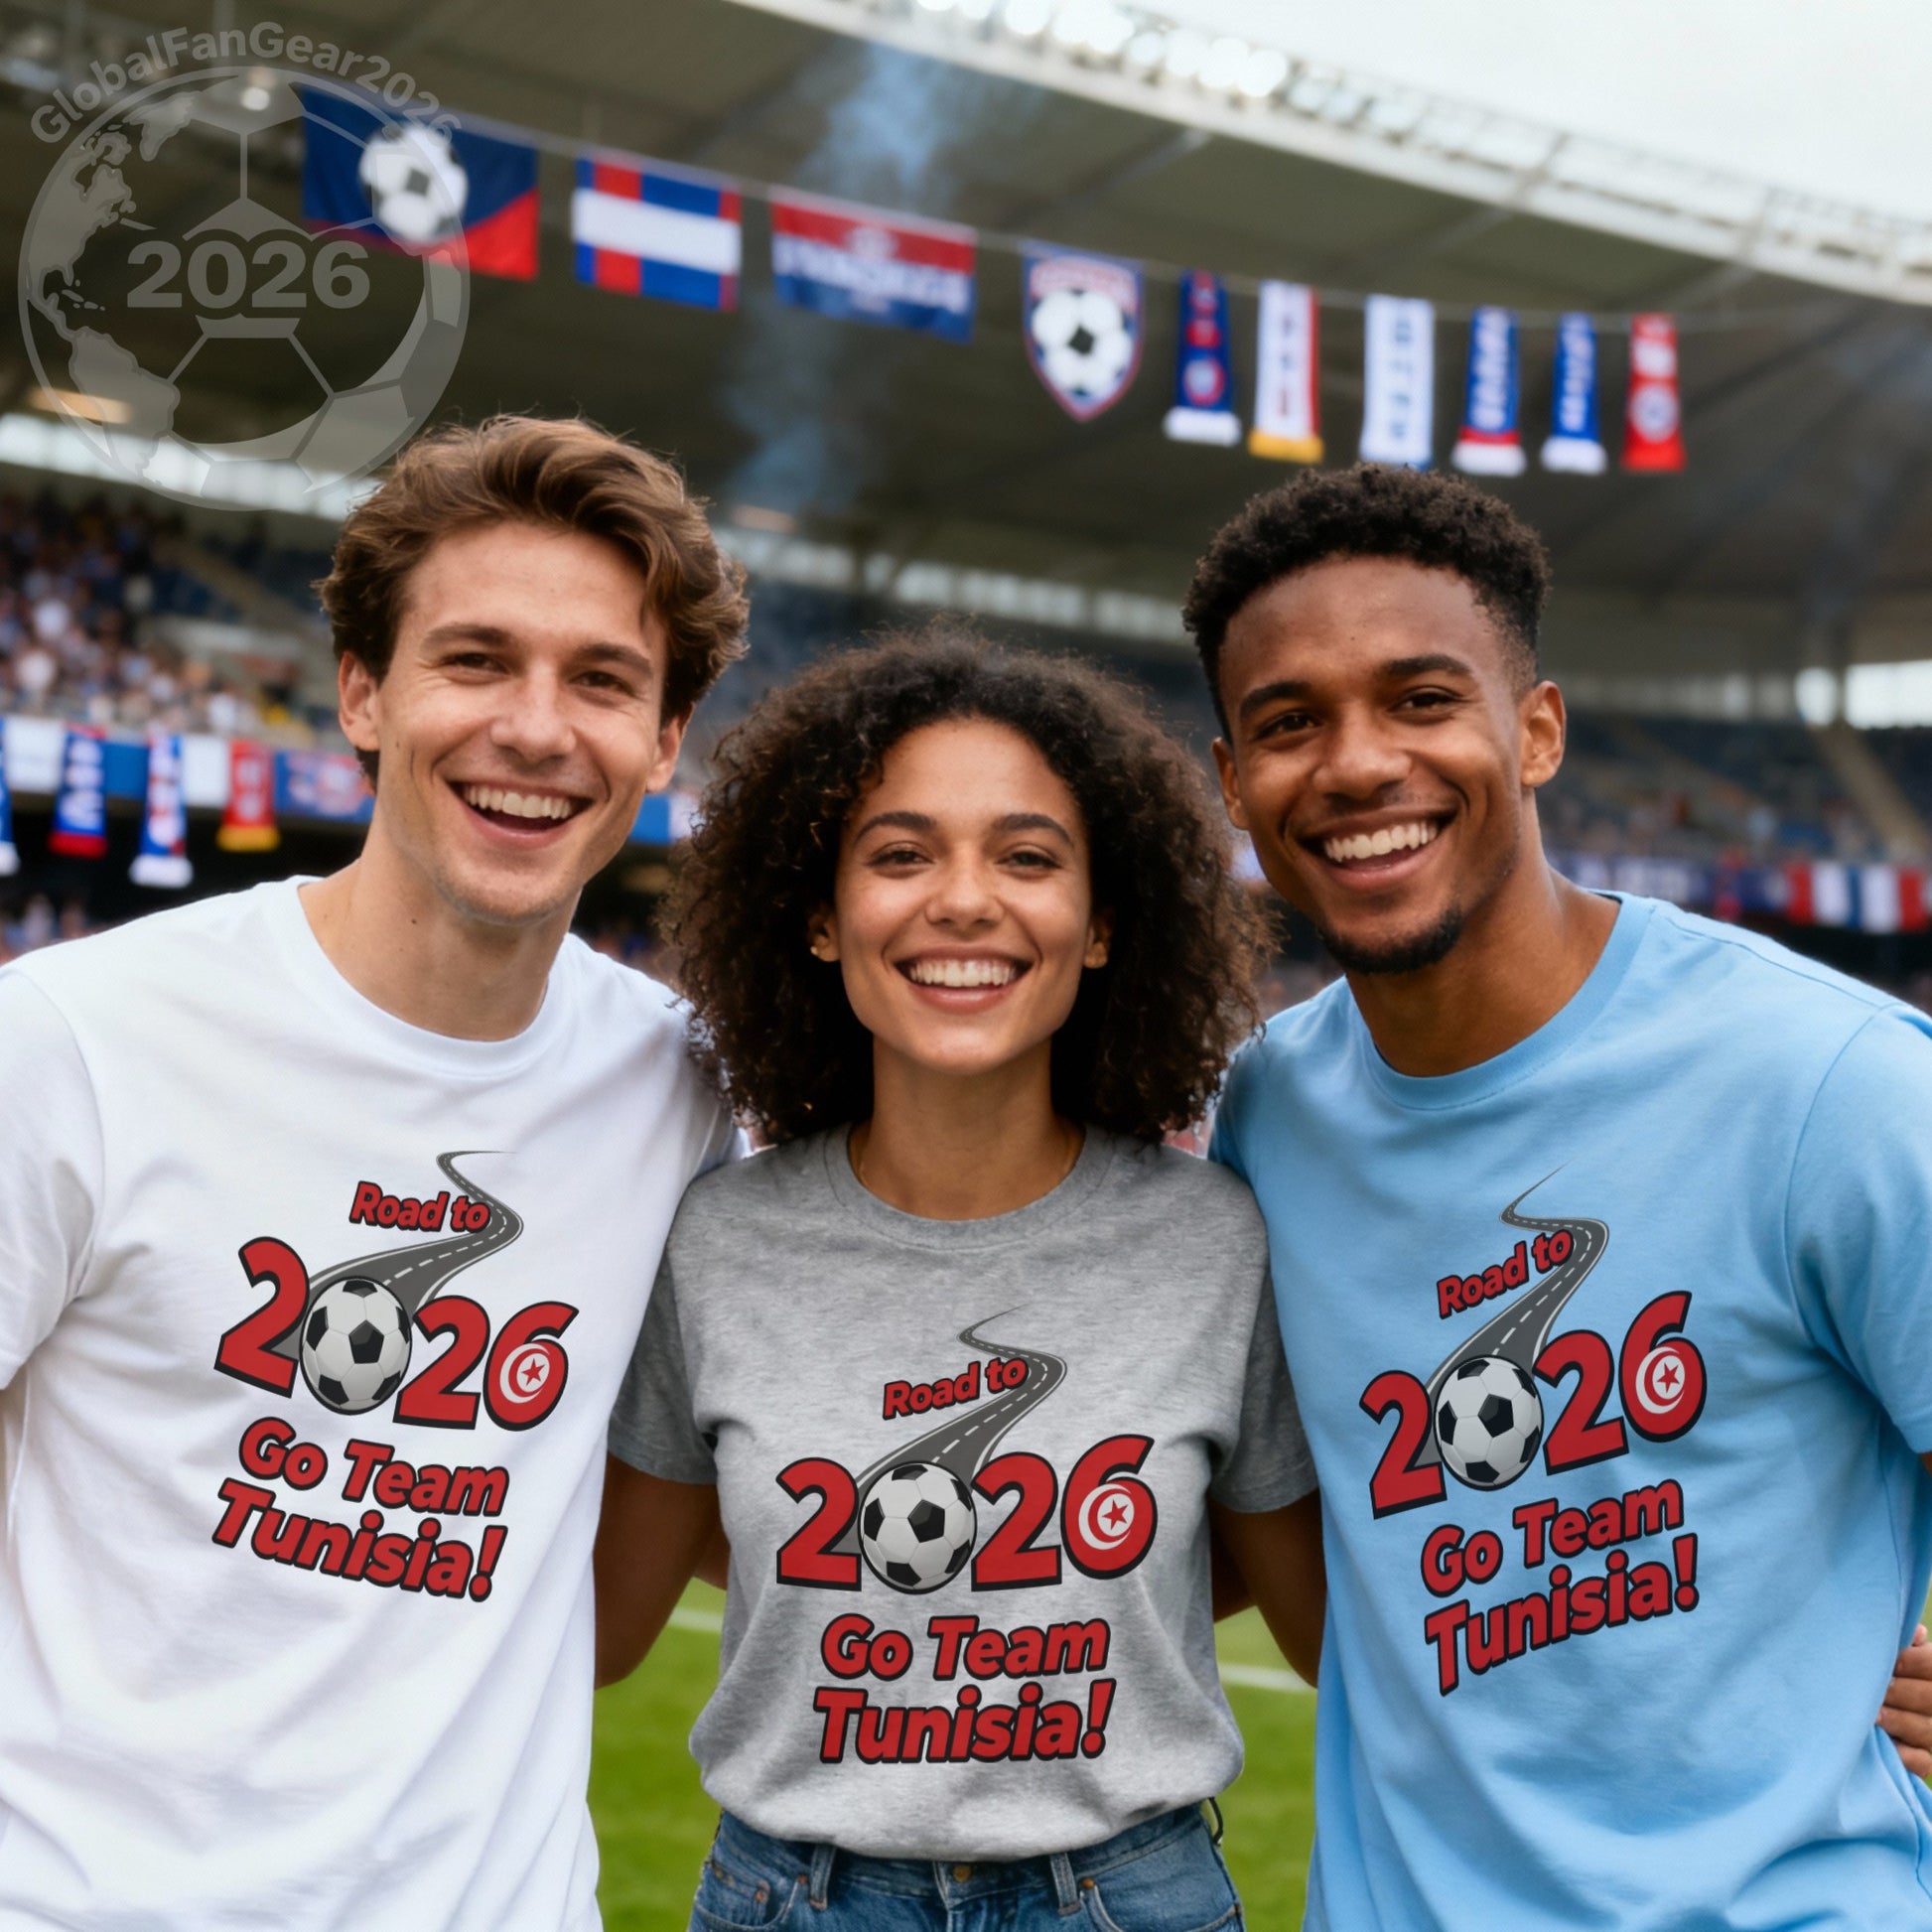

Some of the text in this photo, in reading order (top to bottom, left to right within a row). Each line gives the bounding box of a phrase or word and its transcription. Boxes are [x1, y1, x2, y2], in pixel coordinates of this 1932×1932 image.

[349, 1180, 492, 1233] Road to
[1437, 1228, 1574, 1319] Road to
[883, 1357, 1029, 1421] Road to
[238, 1417, 510, 1517] Go Team
[211, 1477, 508, 1602] Tunisia!
[1421, 1478, 1685, 1597] Go Team
[821, 1613, 1111, 1681] Go Team
[1425, 1533, 1699, 1696] Tunisia!
[813, 1678, 1116, 1764] Tunisia!
